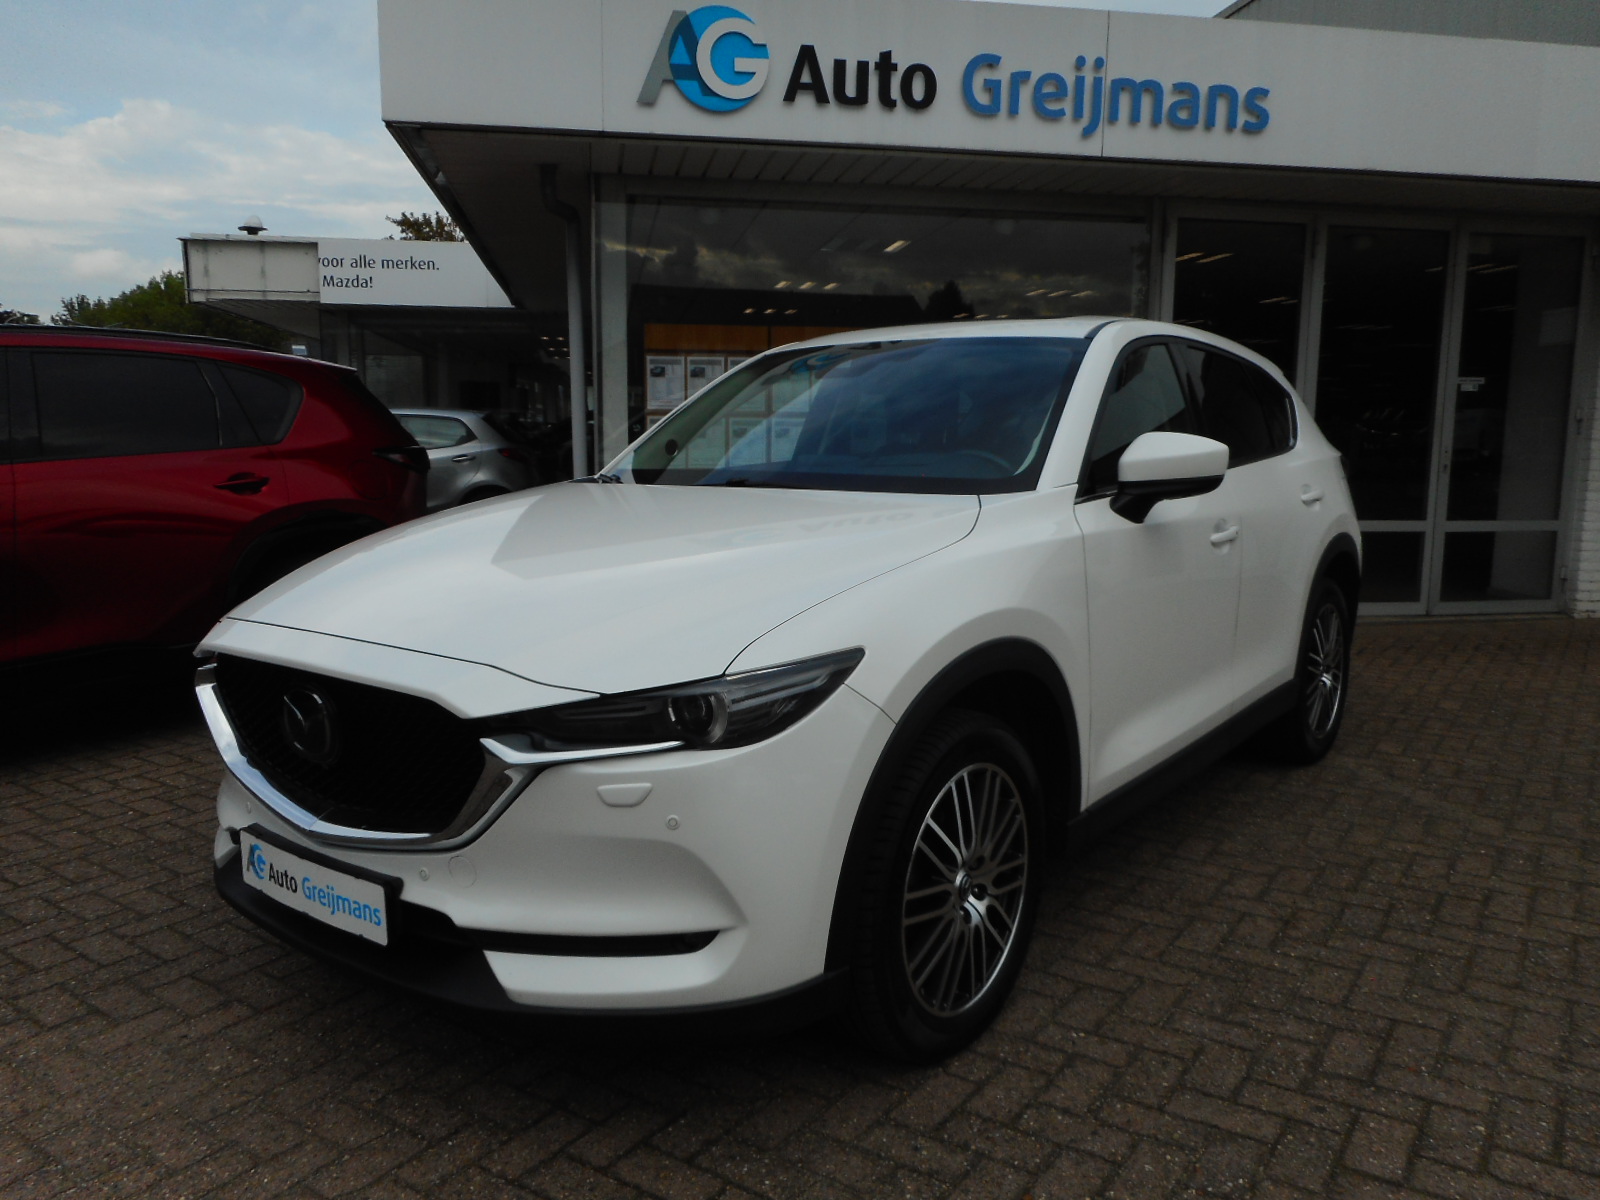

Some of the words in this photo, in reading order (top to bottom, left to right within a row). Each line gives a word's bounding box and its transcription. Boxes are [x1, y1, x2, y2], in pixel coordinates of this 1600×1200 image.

[783, 45, 938, 110] Auto
[962, 53, 1271, 139] Greijmans
[322, 274, 374, 288] Mazda!
[350, 254, 376, 269] alle
[381, 255, 440, 271] merken.
[268, 863, 298, 893] Auto
[302, 877, 382, 926] Greijmans
